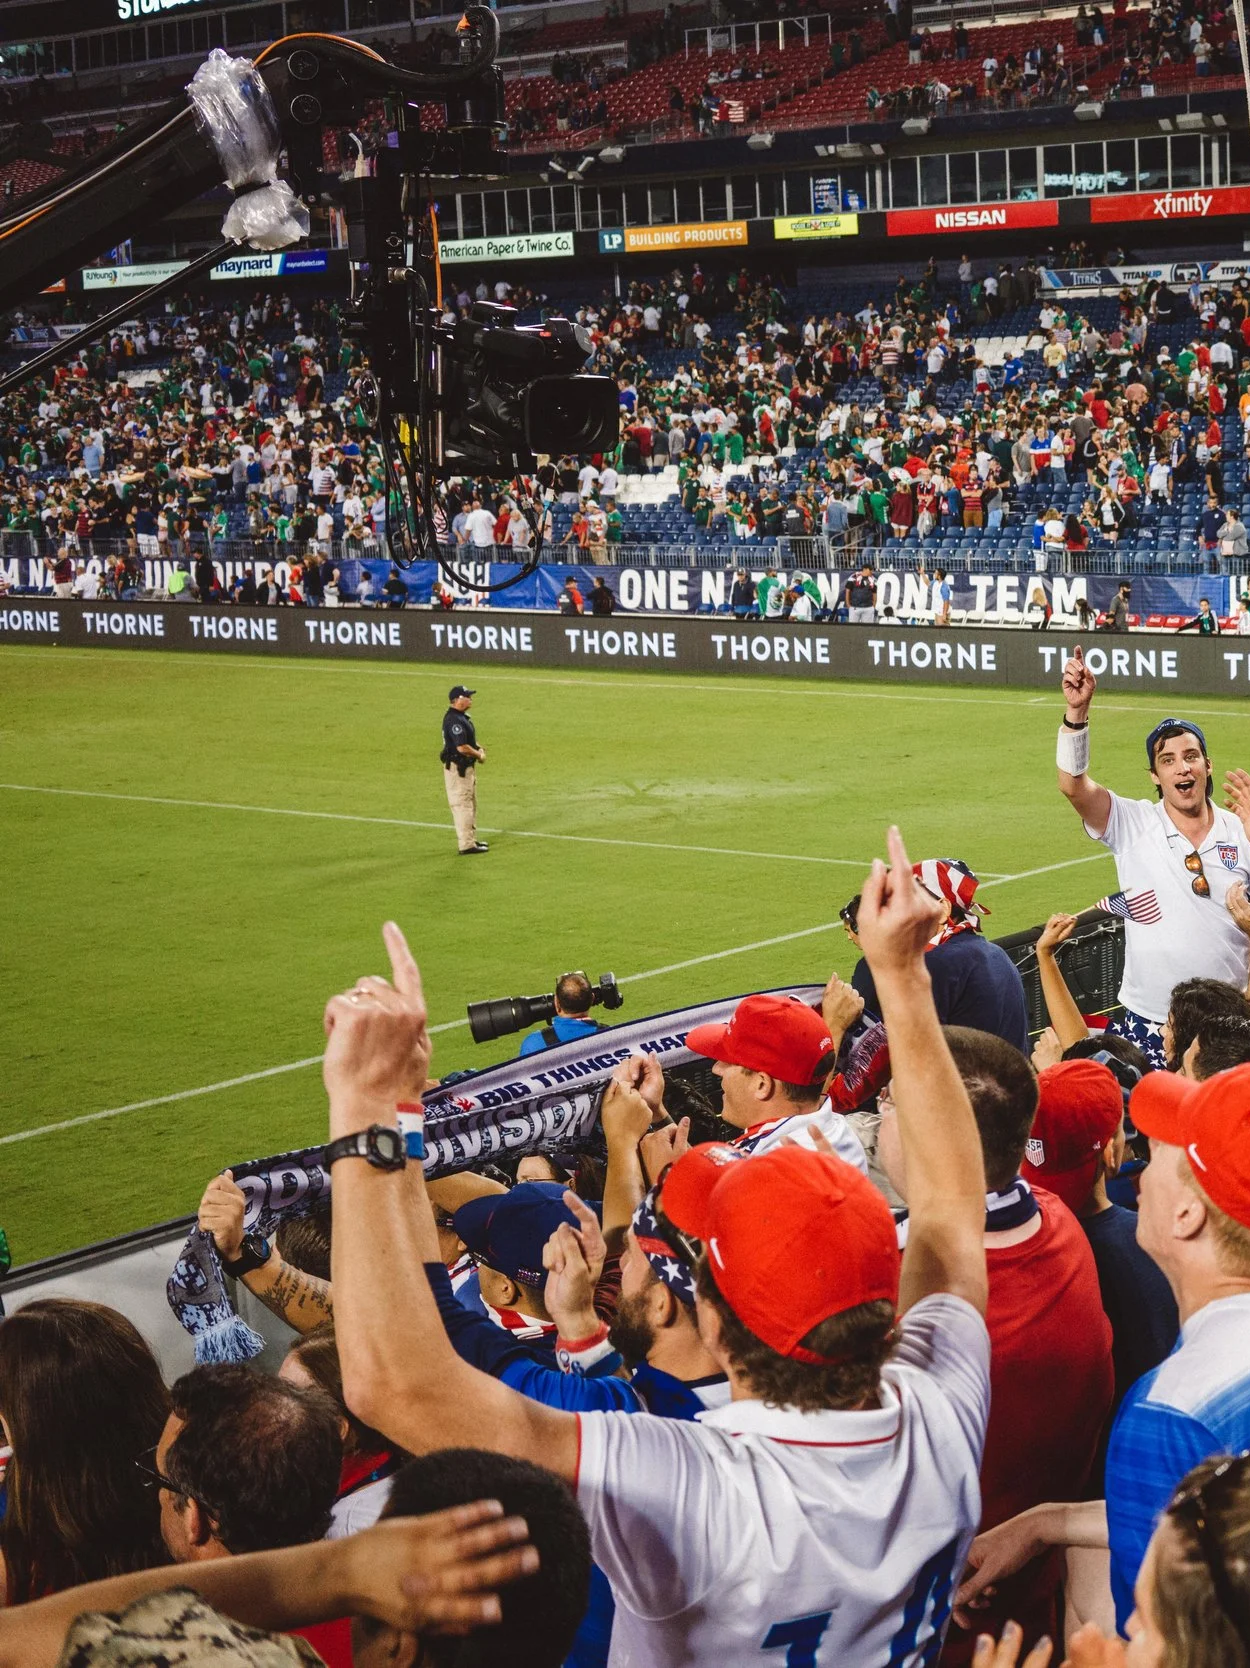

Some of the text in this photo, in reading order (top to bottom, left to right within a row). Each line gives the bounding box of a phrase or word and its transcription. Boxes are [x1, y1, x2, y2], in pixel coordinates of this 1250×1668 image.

[1153, 192, 1213, 218] xfinity
[935, 209, 1006, 229] NISSAN
[603, 234, 623, 249] LP
[629, 227, 743, 246] BUILDING PRODUCTS
[440, 237, 571, 258] American Paper & Twine Co.
[216, 254, 273, 275] maynard
[1122, 270, 1163, 280] TITANUP
[1069, 270, 1102, 285] TITANS
[618, 568, 690, 611] ONE
[875, 572, 954, 617] ON
[969, 575, 1088, 616] TEAM
[0, 610, 60, 632] HORNE
[82, 612, 165, 636] THORNE
[189, 616, 278, 641] THORNE
[305, 620, 402, 646] THORNE
[430, 624, 533, 651] THORNE
[565, 629, 677, 658] THORNE
[711, 635, 830, 664] THORNE
[868, 640, 996, 671] THORNE
[474, 1031, 690, 1109] BIG THINGS HAP
